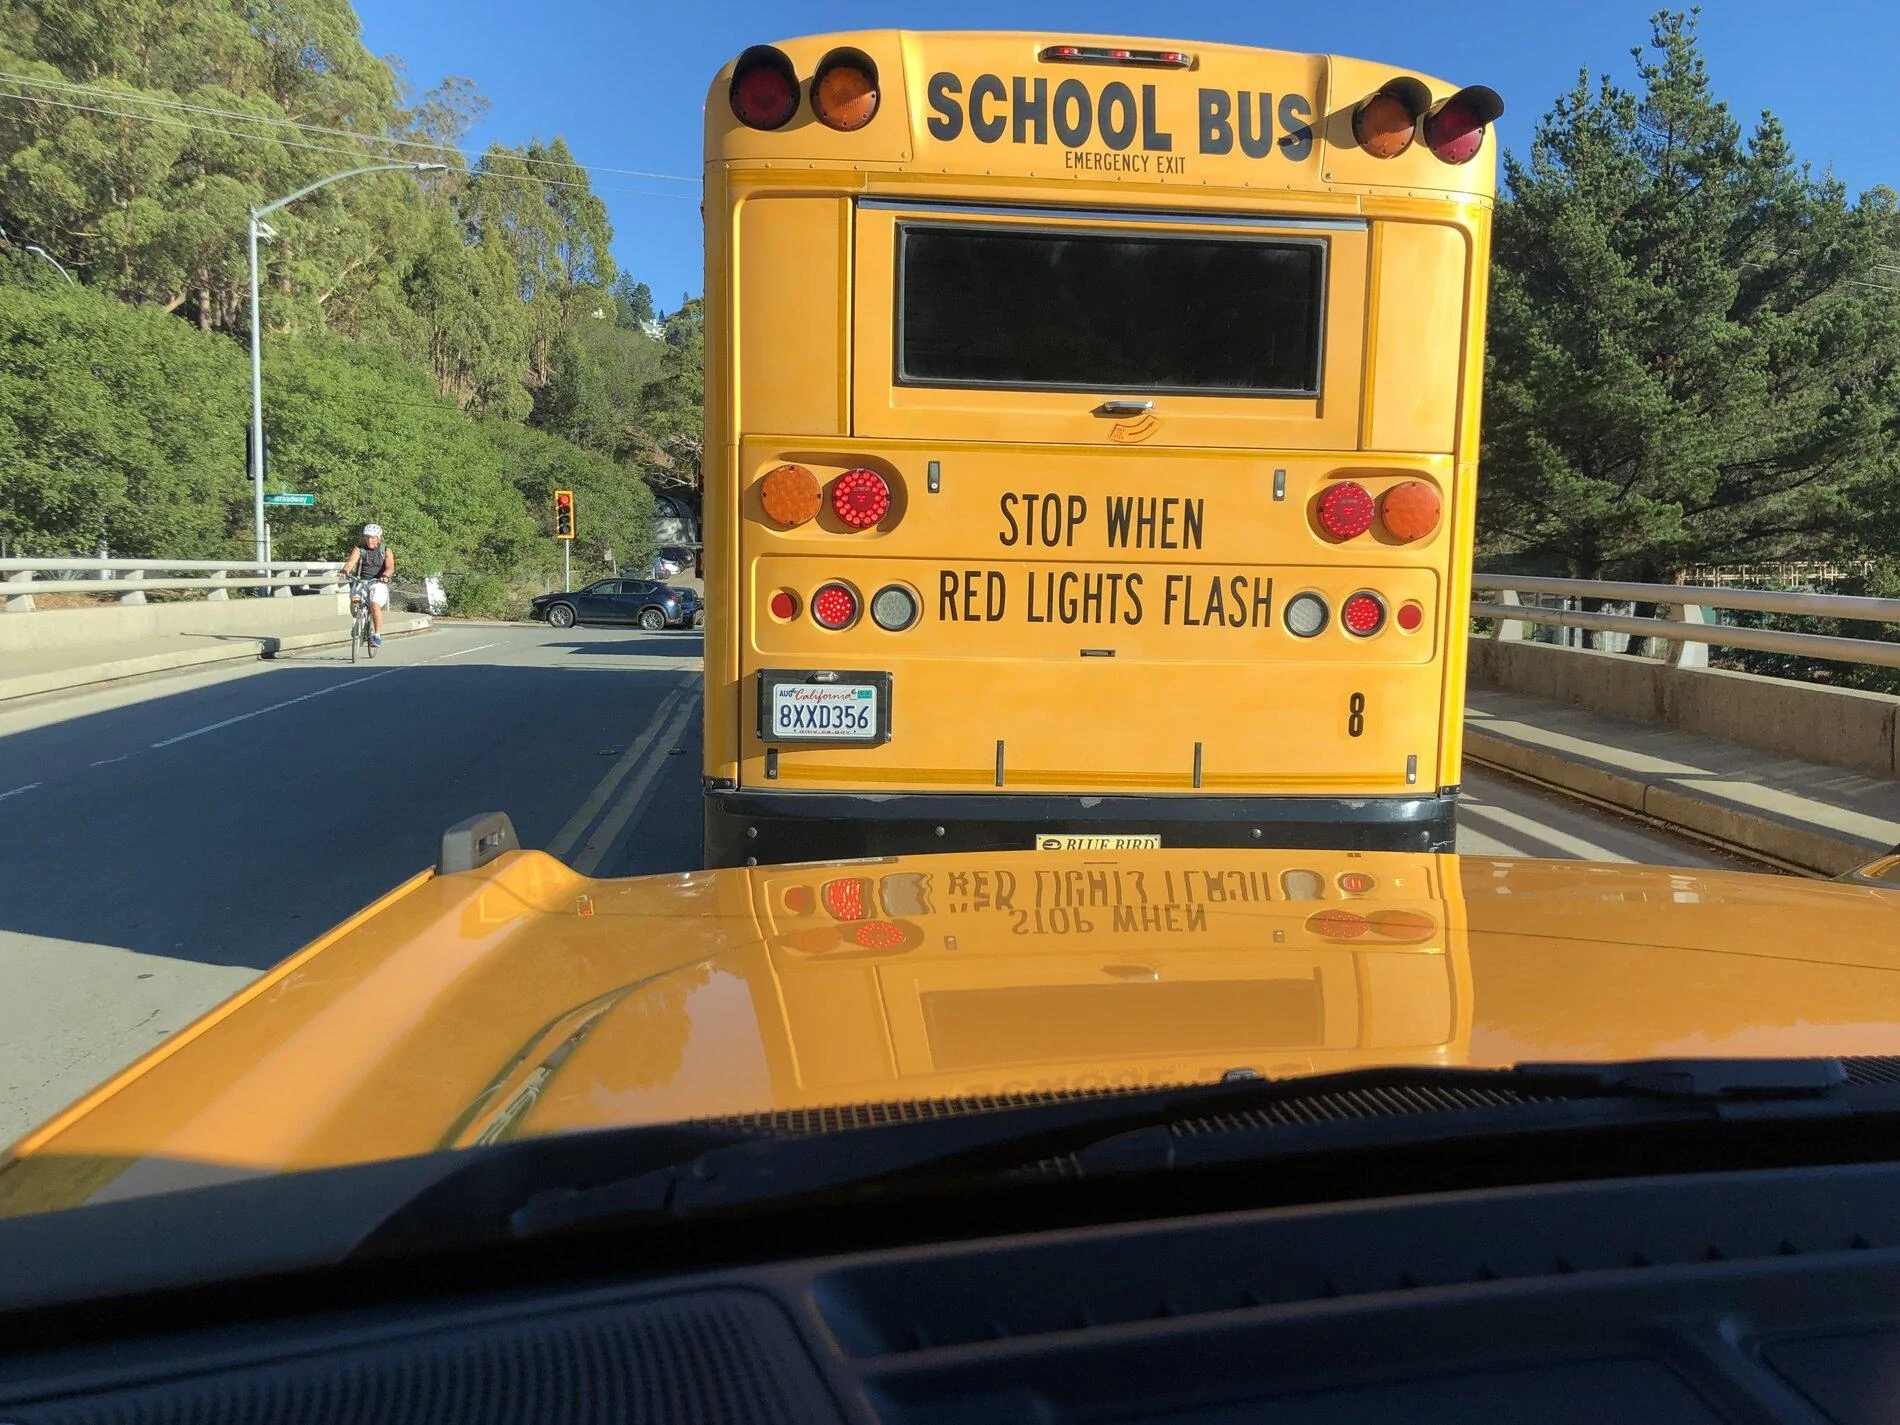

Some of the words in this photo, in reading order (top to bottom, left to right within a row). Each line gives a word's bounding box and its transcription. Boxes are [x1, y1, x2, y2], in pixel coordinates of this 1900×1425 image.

[926, 71, 1173, 152] SCHOOL
[1198, 87, 1313, 162] BUS
[1065, 150, 1150, 174] EMERGENCY
[1157, 155, 1187, 175] EXIT
[999, 491, 1088, 547] STOP
[1106, 495, 1204, 550] WHEN
[939, 569, 1006, 622] RED
[1027, 571, 1144, 626] LIGHTS
[1163, 574, 1274, 628] FLASH
[779, 689, 793, 698] AUG
[795, 688, 853, 704] California
[780, 704, 870, 729] 8XXD356
[1348, 691, 1365, 738] 8
[1066, 838, 1110, 850] BLUE
[1115, 838, 1155, 850] BIRD
